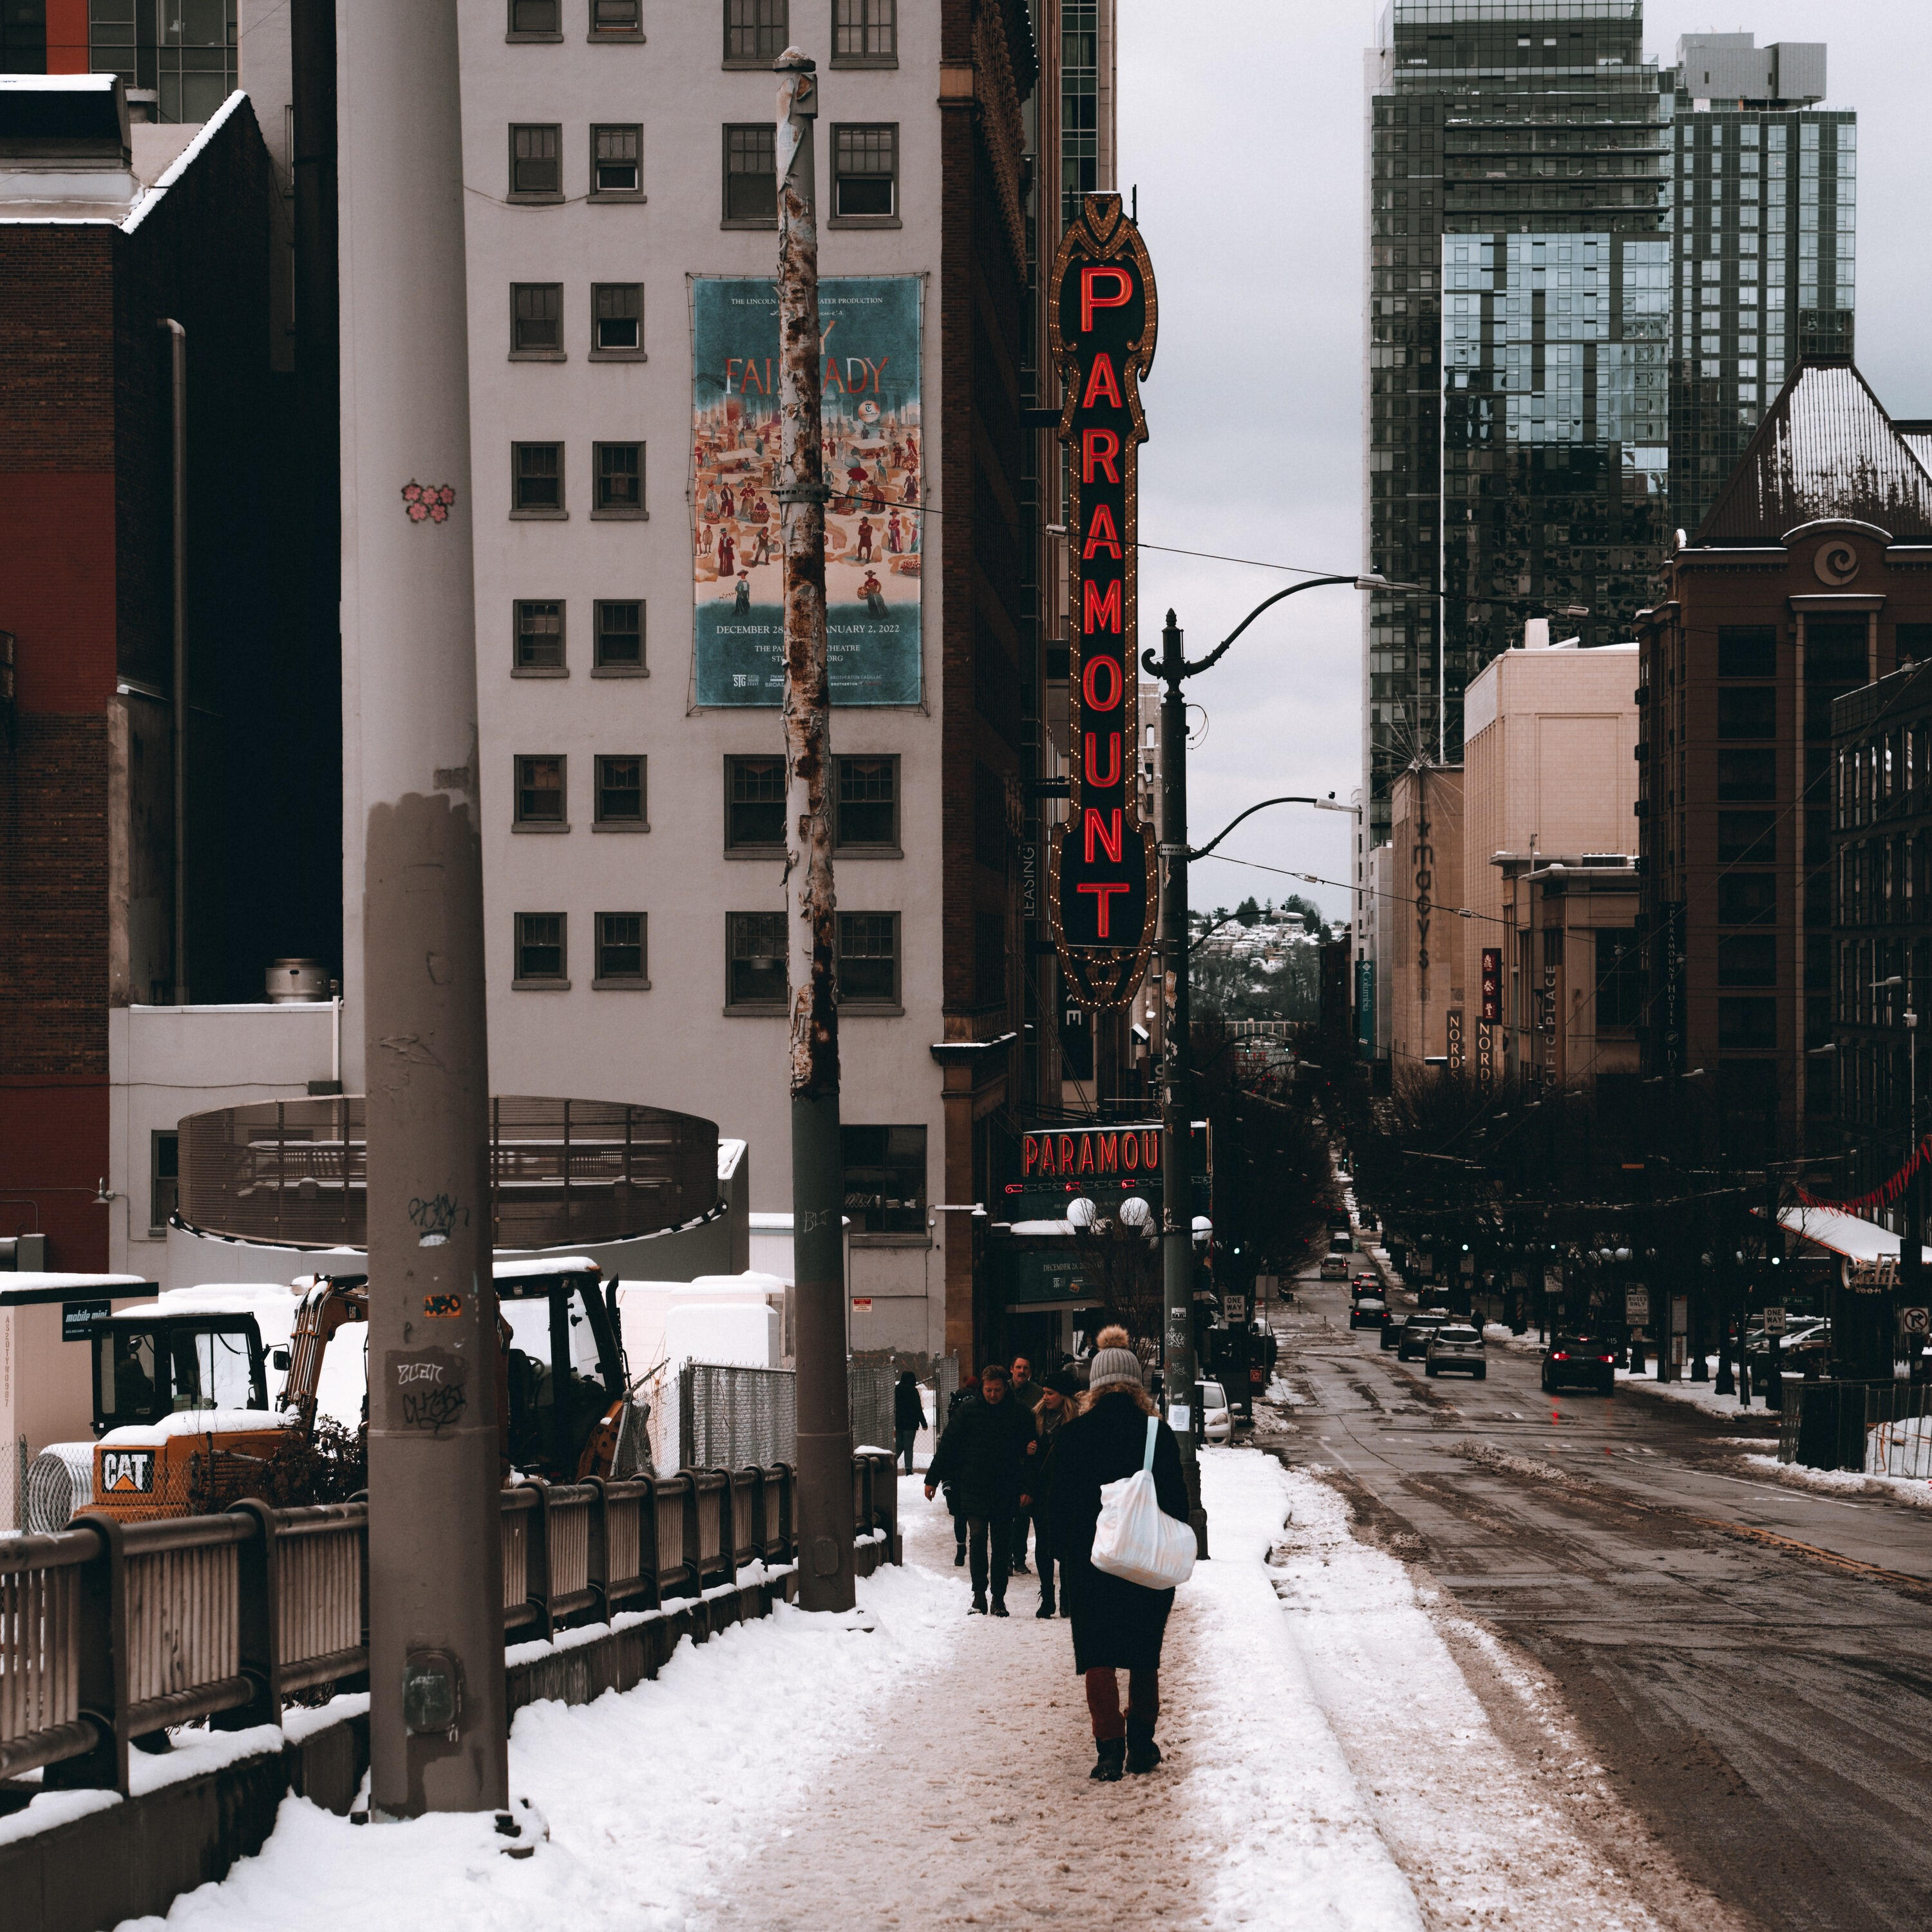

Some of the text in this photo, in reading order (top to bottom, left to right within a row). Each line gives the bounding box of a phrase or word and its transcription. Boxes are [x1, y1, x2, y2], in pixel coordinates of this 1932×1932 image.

[724, 357, 890, 395] FAI ADY
[1076, 267, 1133, 938] PARAMOUNT
[716, 625, 770, 634] DECEMBER
[878, 625, 900, 633] 2022
[1024, 846, 1035, 916] LEASING
[1667, 909, 1676, 1025] PARAMOUNT HOTEL
[1362, 971, 1371, 1012] Columbia
[1545, 965, 1556, 1025] PLACE
[1022, 1131, 1161, 1177] PARAMOU
[1043, 1262, 1071, 1272] DECEMBER
[66, 1309, 108, 1323] mobile mini
[104, 1453, 147, 1491] CAT
